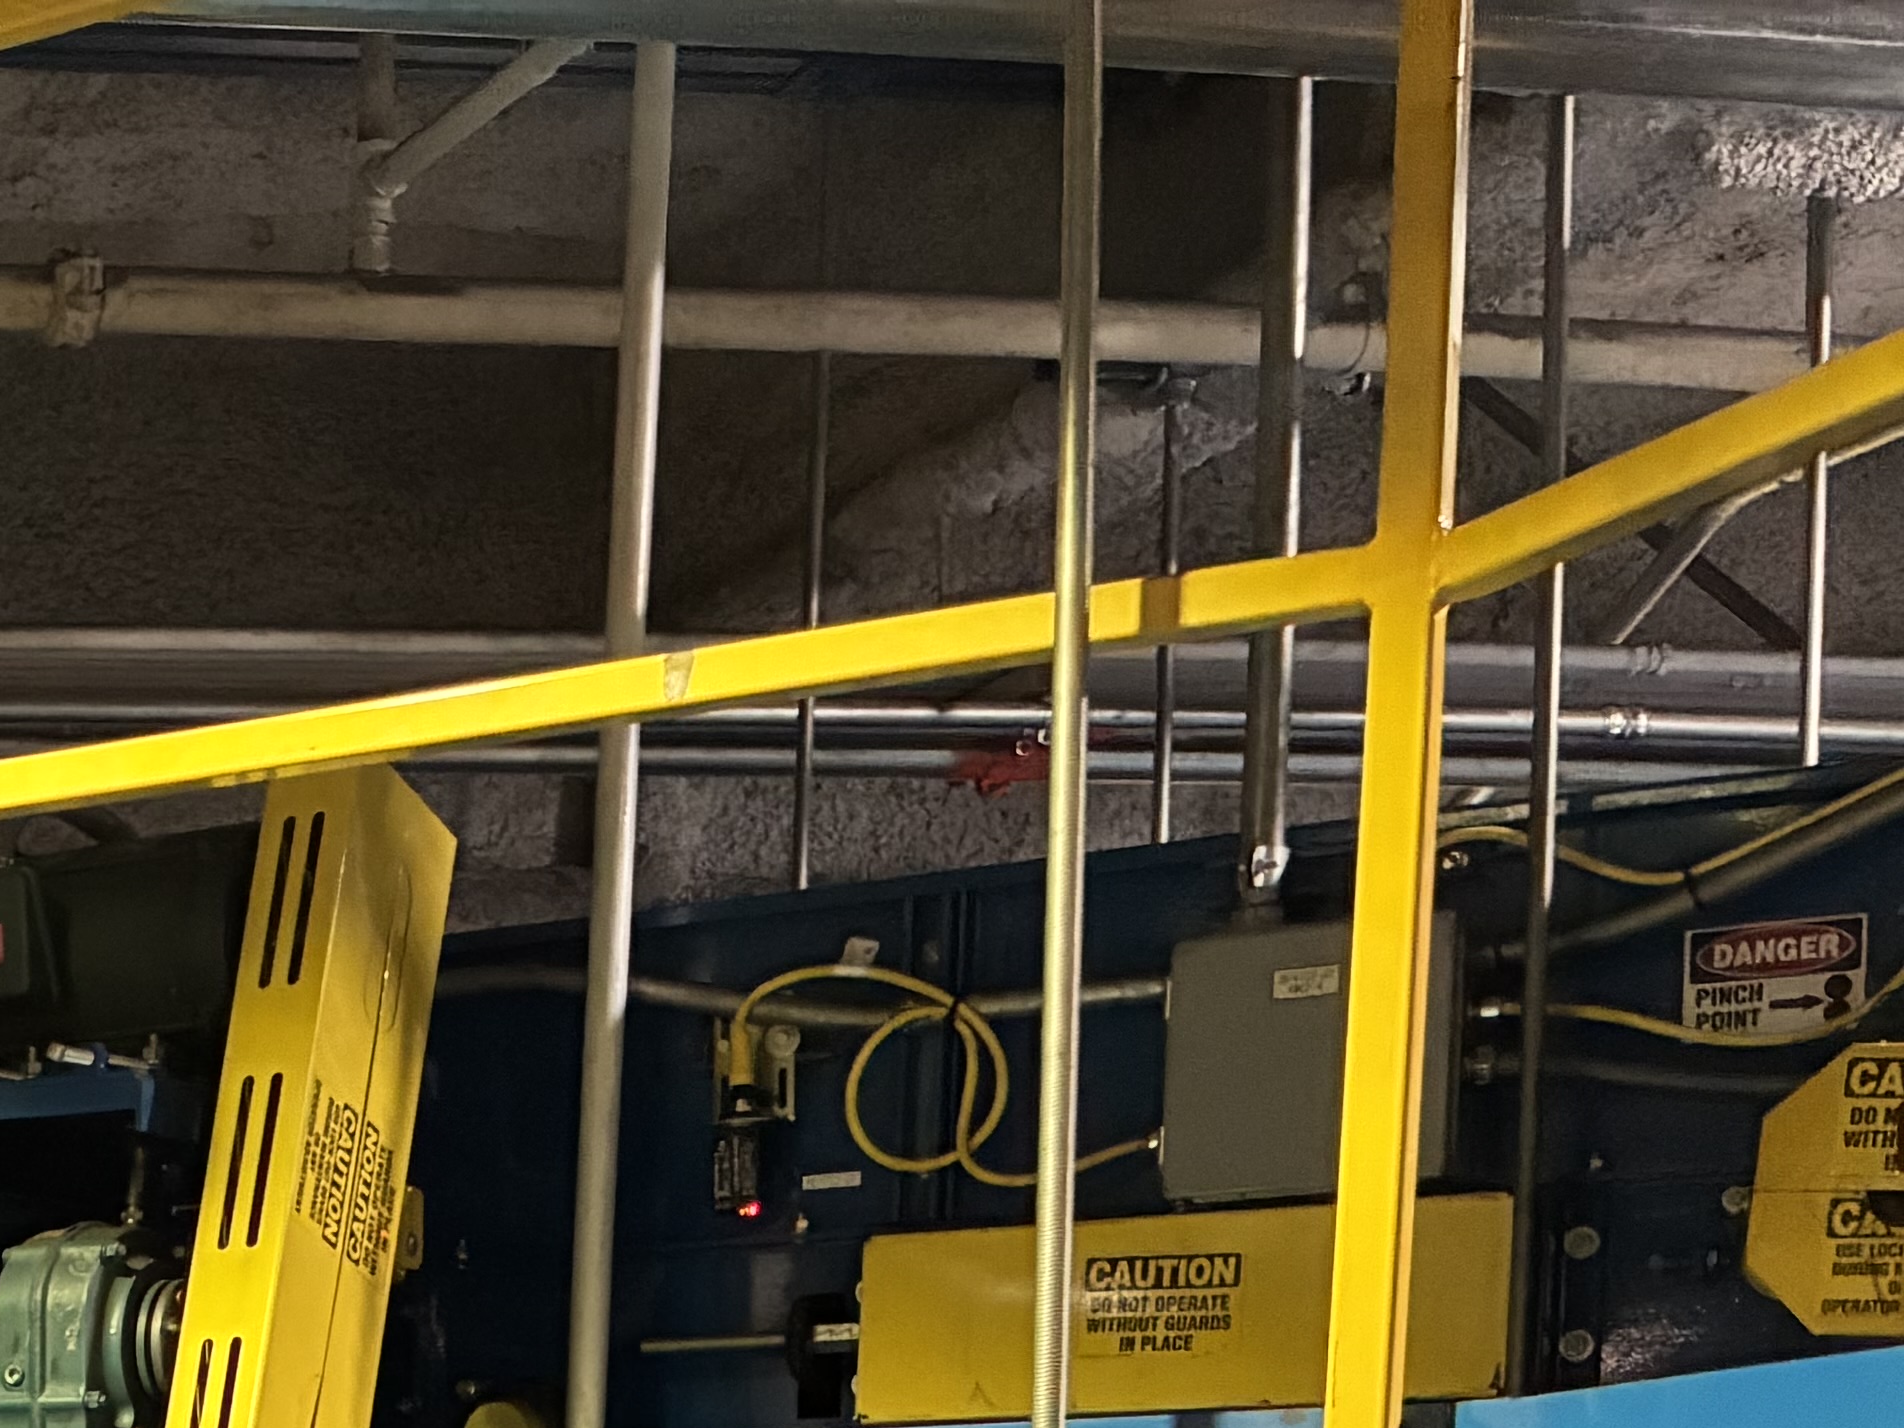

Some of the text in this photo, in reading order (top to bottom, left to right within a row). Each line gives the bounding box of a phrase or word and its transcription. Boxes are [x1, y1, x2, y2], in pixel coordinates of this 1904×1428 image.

[1712, 932, 1840, 969] DANGER
[1695, 982, 1764, 1009] PINCH
[1695, 1008, 1762, 1031] POINT
[1850, 1106, 1878, 1125] DO
[323, 1107, 356, 1245] CAUTION
[347, 1125, 379, 1262] CAUTION
[1088, 1256, 1237, 1289] CAUTION
[1117, 1295, 1149, 1313] NOT
[1154, 1294, 1231, 1312] OPERATE
[1087, 1314, 1232, 1333] WITHOUT GUARDS
[1118, 1335, 1194, 1352] IN PLACE
